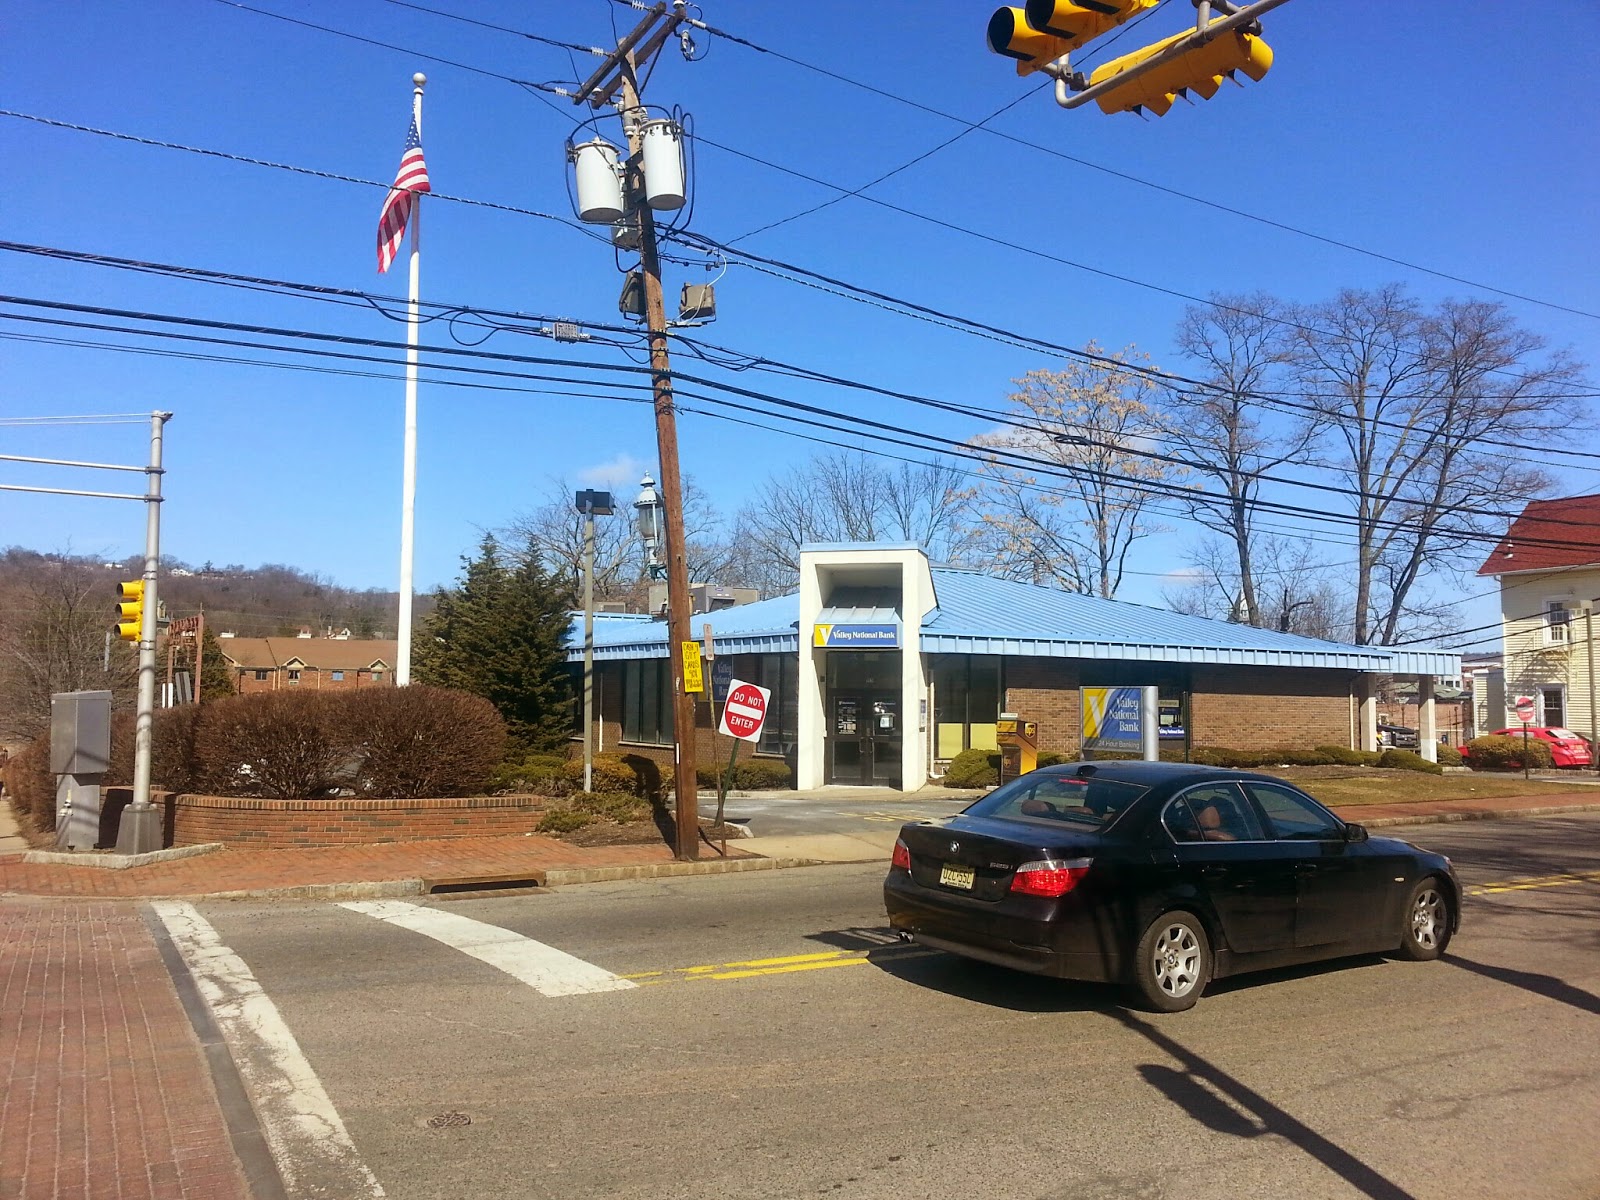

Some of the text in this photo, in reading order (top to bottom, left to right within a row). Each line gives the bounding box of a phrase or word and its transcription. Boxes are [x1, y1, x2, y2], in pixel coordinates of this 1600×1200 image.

[833, 630, 895, 640] Valley National Bank
[717, 662, 732, 676] Valley
[734, 692, 762, 707] DO NOT
[1116, 694, 1139, 710] Valley
[1109, 709, 1139, 720] National
[731, 716, 754, 729] ENTER
[1119, 720, 1139, 732] Bank
[1119, 740, 1140, 749] Banking
